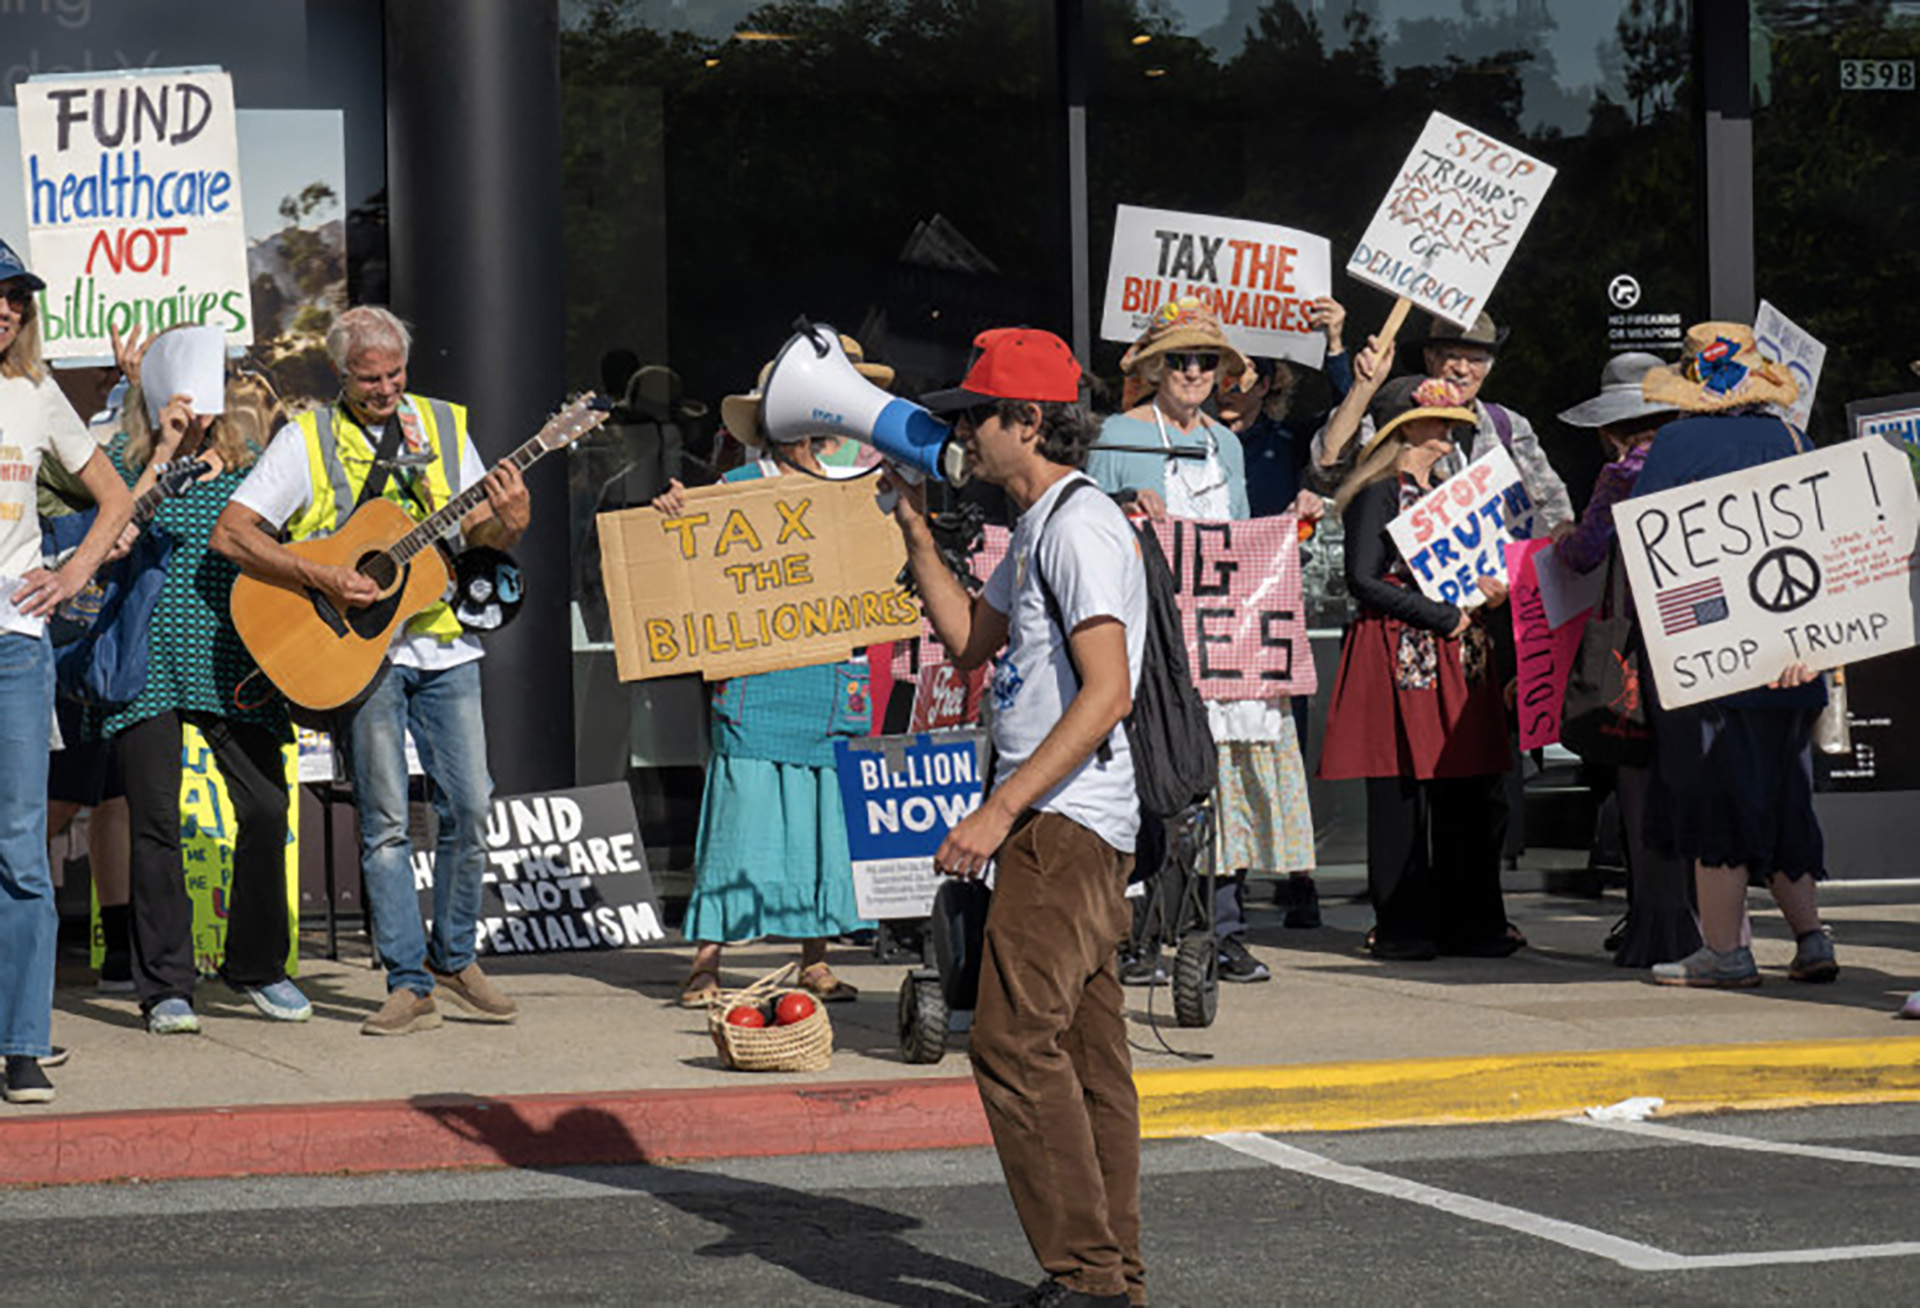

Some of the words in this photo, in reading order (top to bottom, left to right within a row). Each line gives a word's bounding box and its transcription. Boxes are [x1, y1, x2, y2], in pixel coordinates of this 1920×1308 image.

[1842, 61, 1912, 88] 359B
[47, 83, 212, 151] FUND
[1411, 150, 1528, 220] TRUMP'S
[1446, 129, 1536, 179] STOP
[30, 150, 231, 224] healthcare
[85, 227, 187, 276] NOT
[1155, 230, 1224, 283] TAX
[1228, 239, 1298, 293] THE
[1409, 234, 1449, 259] OF
[39, 277, 247, 342] billionaires
[1352, 243, 1475, 319] DEMOCRACY!
[661, 499, 815, 559] TAX
[1408, 481, 1533, 582] TRUTH
[1410, 463, 1492, 543] STOP
[1636, 471, 1830, 589] RESIST
[725, 554, 814, 594] THE
[646, 590, 919, 662] BILLIONAIRES
[1674, 639, 1759, 689] STOP
[1784, 612, 1889, 659] TRUMP
[485, 796, 582, 848] UND
[866, 792, 983, 834] NOW
[499, 875, 592, 912] NOT
[426, 902, 665, 952] PERIALISM
